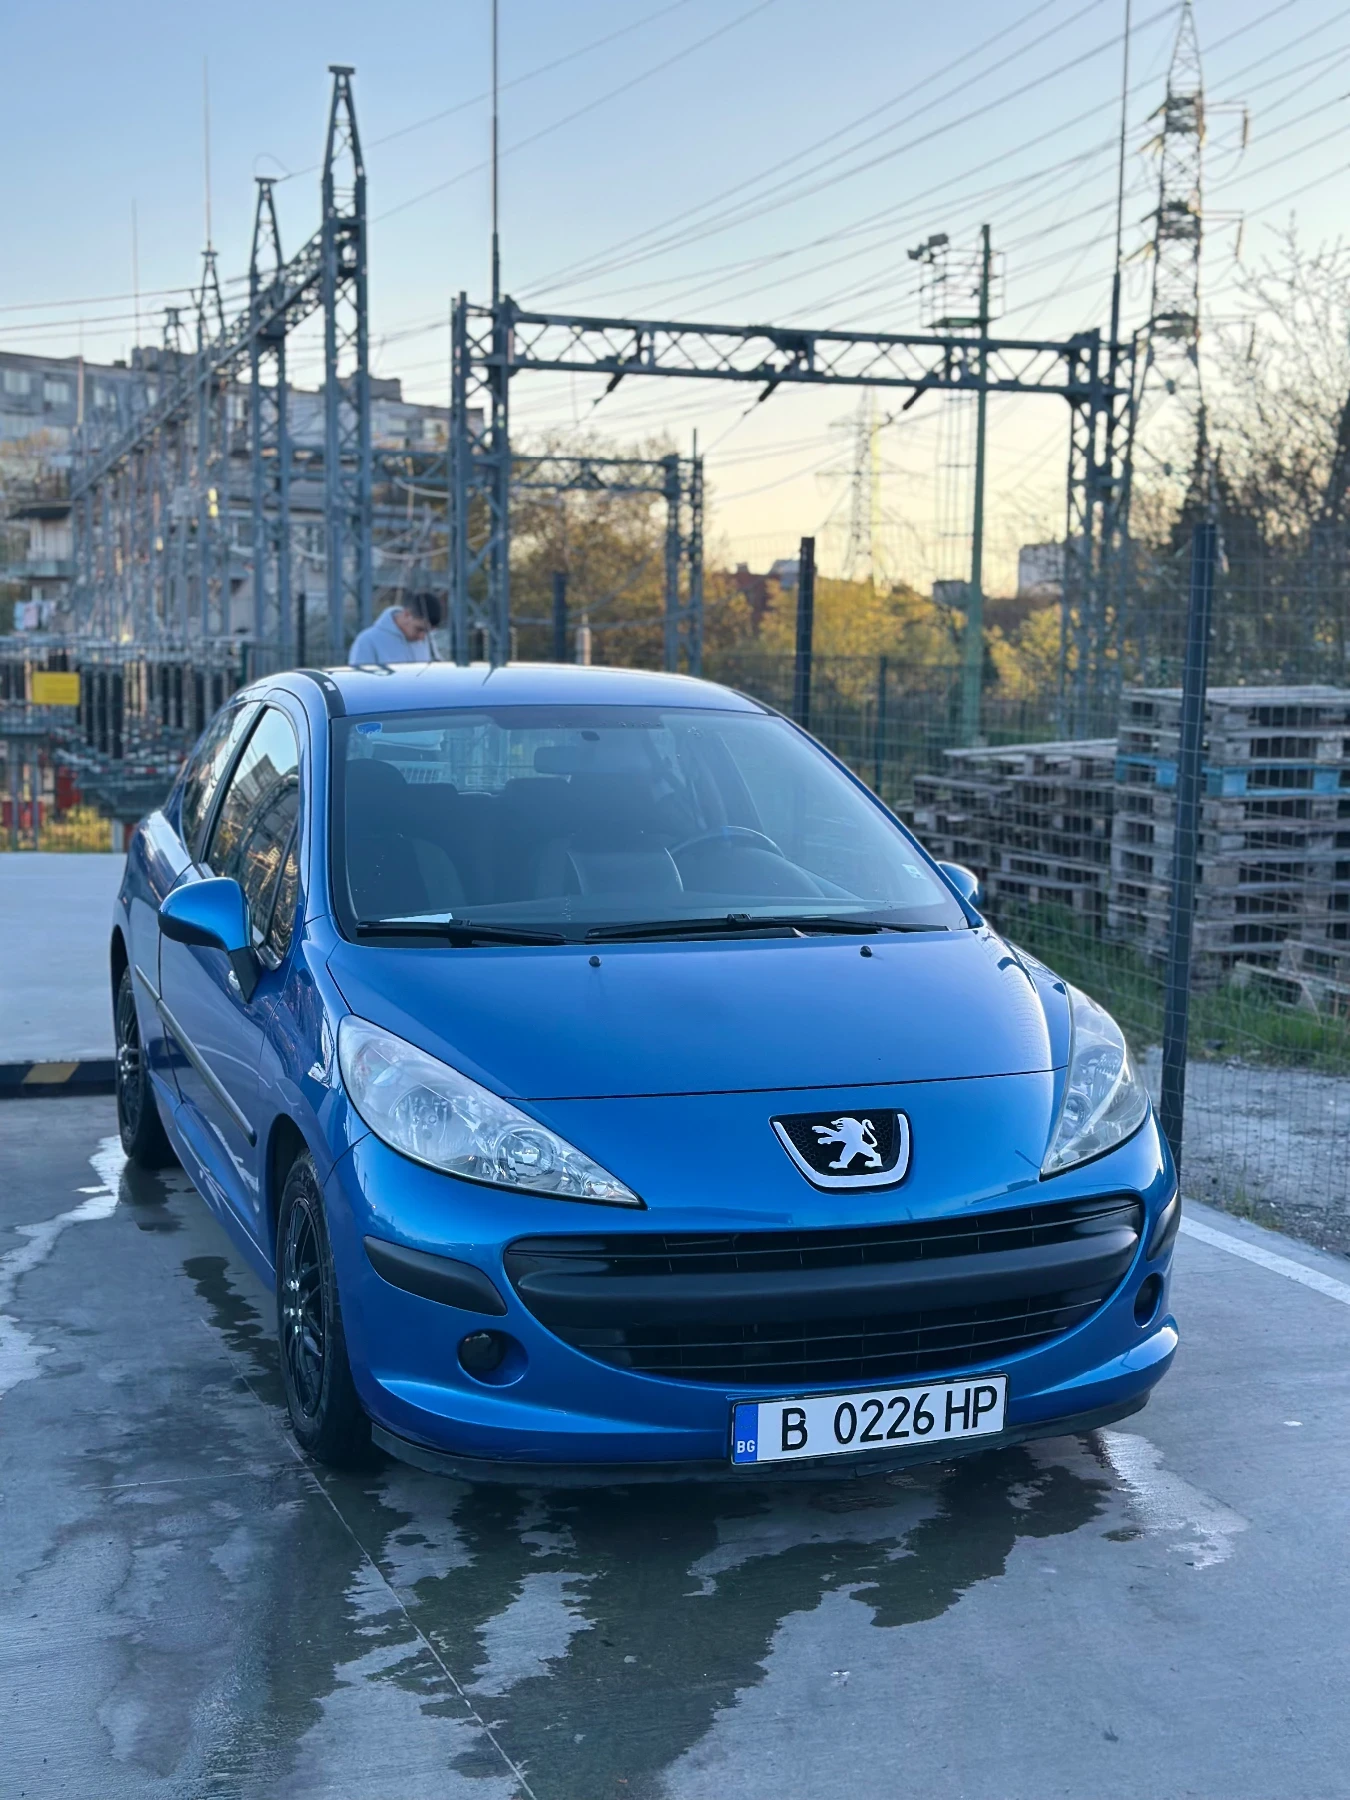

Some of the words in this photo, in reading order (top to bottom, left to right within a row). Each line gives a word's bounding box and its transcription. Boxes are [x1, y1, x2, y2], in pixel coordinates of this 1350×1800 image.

[781, 1407, 808, 1451] B
[833, 1393, 935, 1444] 0226
[945, 1385, 998, 1432] HP
[736, 1440, 756, 1453] BG
